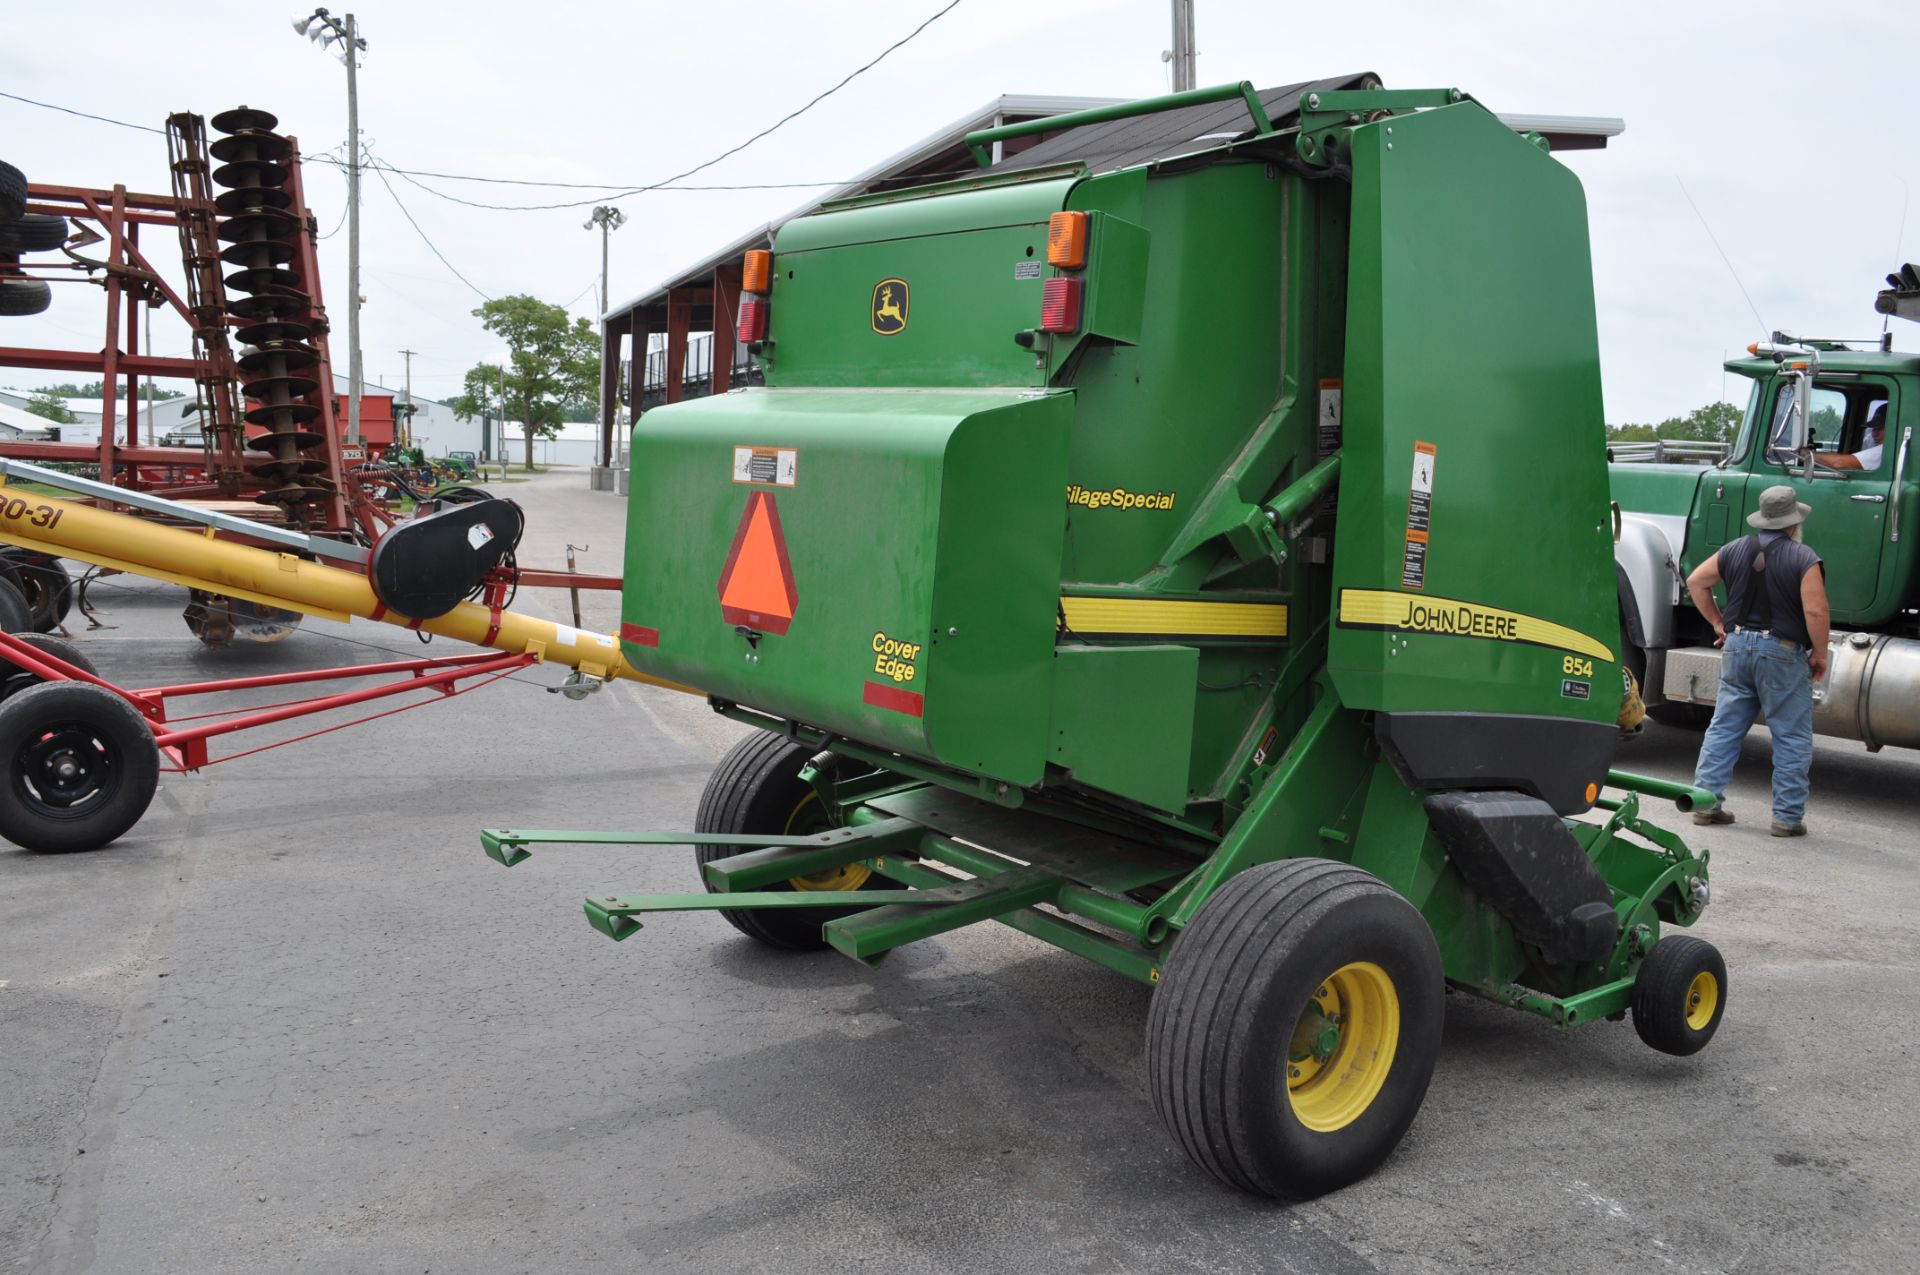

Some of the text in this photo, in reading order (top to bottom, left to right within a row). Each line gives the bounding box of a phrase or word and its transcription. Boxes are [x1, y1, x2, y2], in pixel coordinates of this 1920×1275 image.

[1400, 600, 1518, 637] JOHN DEERE
[872, 632, 921, 661] Cover
[874, 654, 915, 682] Edge
[1562, 655, 1593, 678] 854
